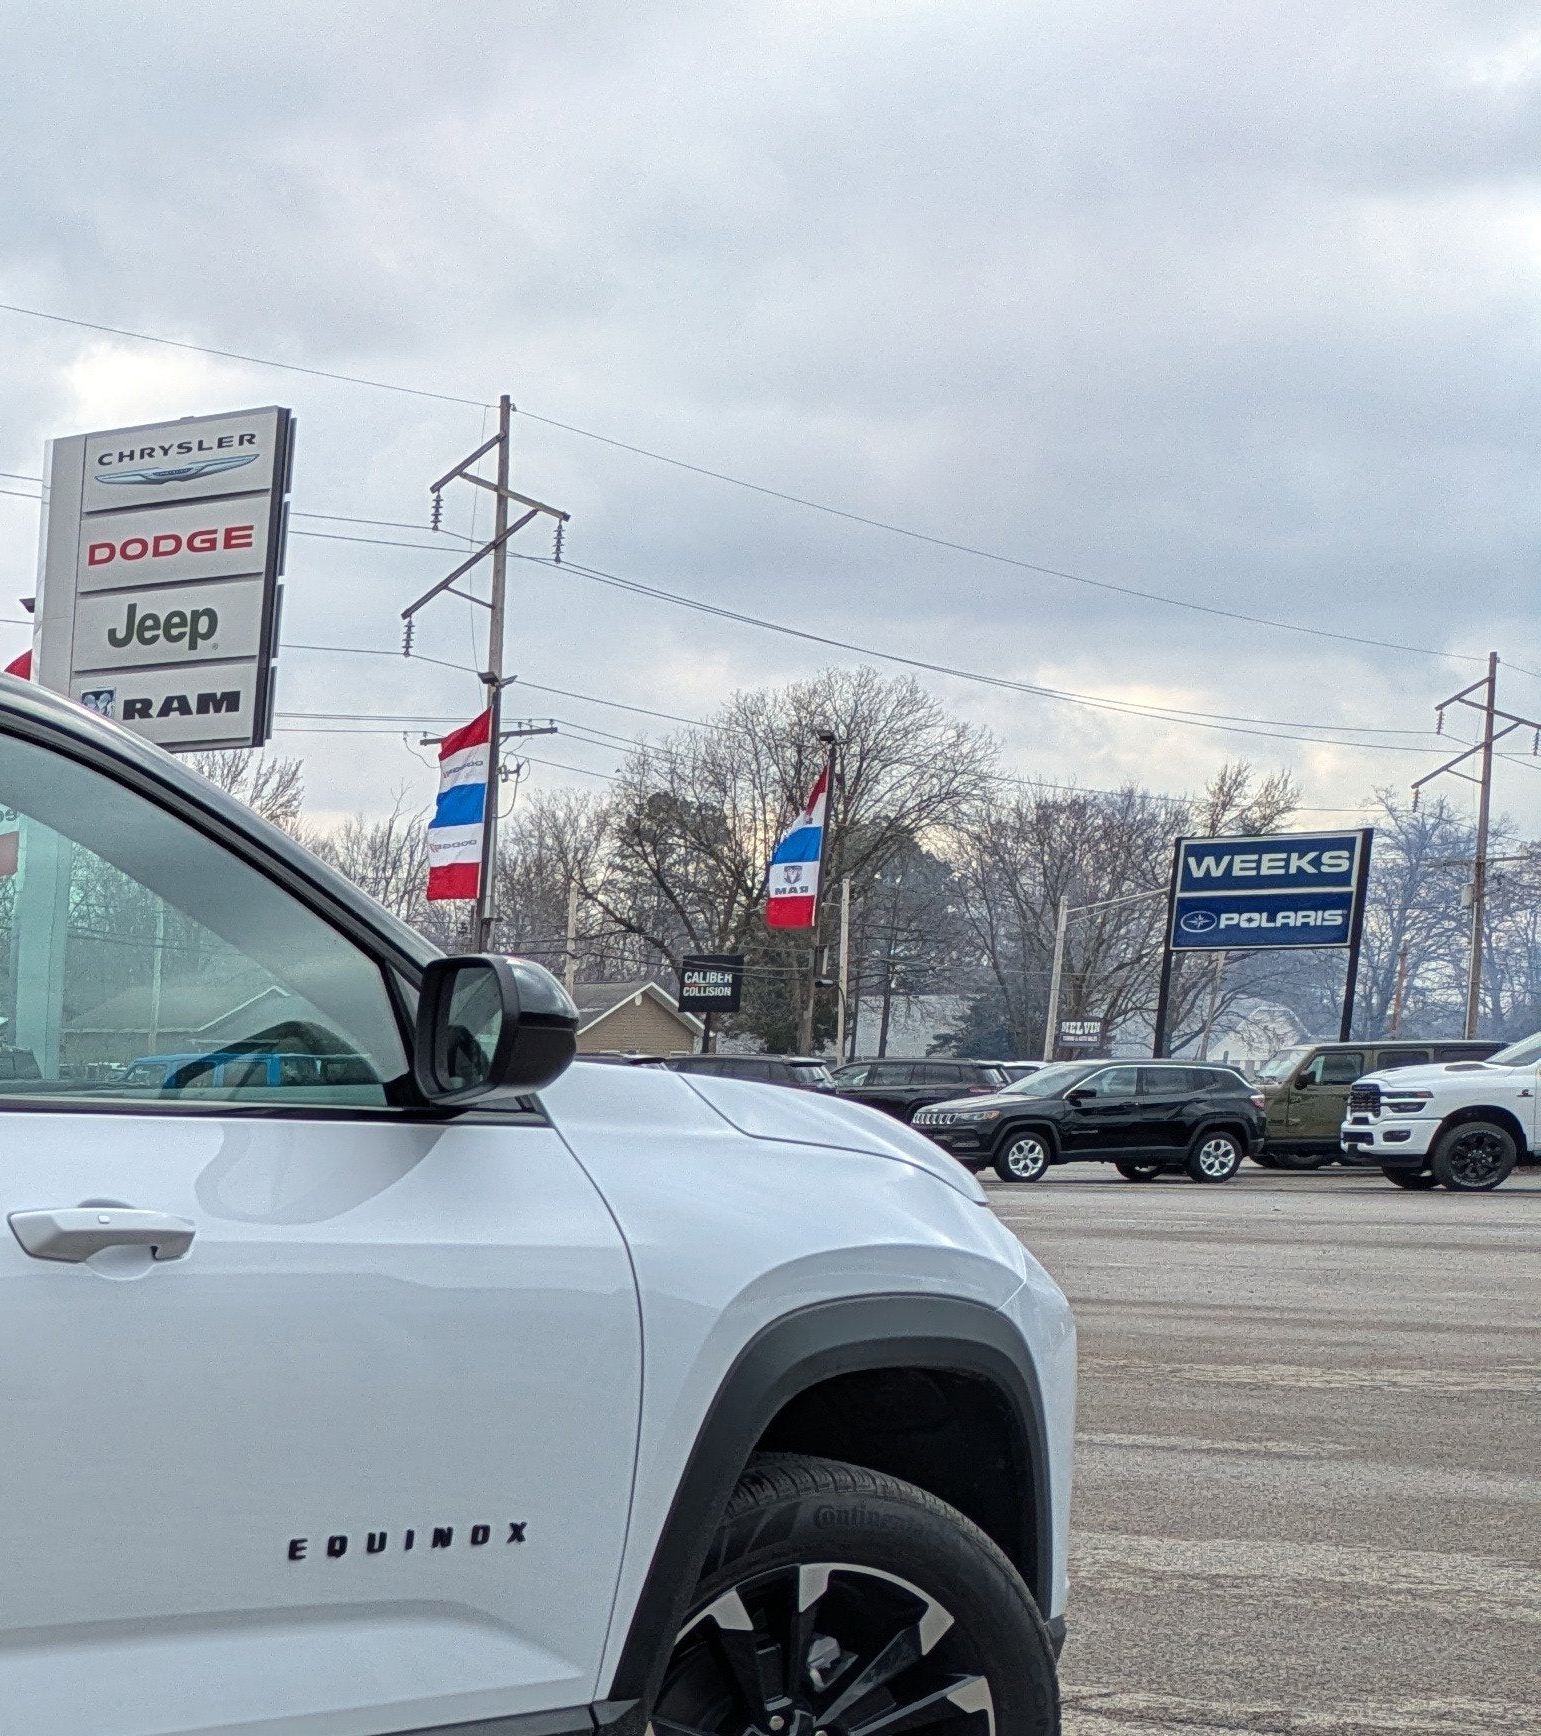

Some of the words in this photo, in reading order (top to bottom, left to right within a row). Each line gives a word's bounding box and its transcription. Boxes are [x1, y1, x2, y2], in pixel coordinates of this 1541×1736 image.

[97, 432, 257, 466] CHRYSLER
[87, 524, 255, 566] DODGE
[107, 603, 218, 651] Jeep
[122, 690, 241, 721] RAM
[1187, 850, 1350, 878] WEEKS
[1219, 909, 1343, 929] POLARIS
[683, 986, 732, 997] COLLISION
[684, 971, 733, 984] CALIBER
[288, 1521, 528, 1560] EQUINOX
